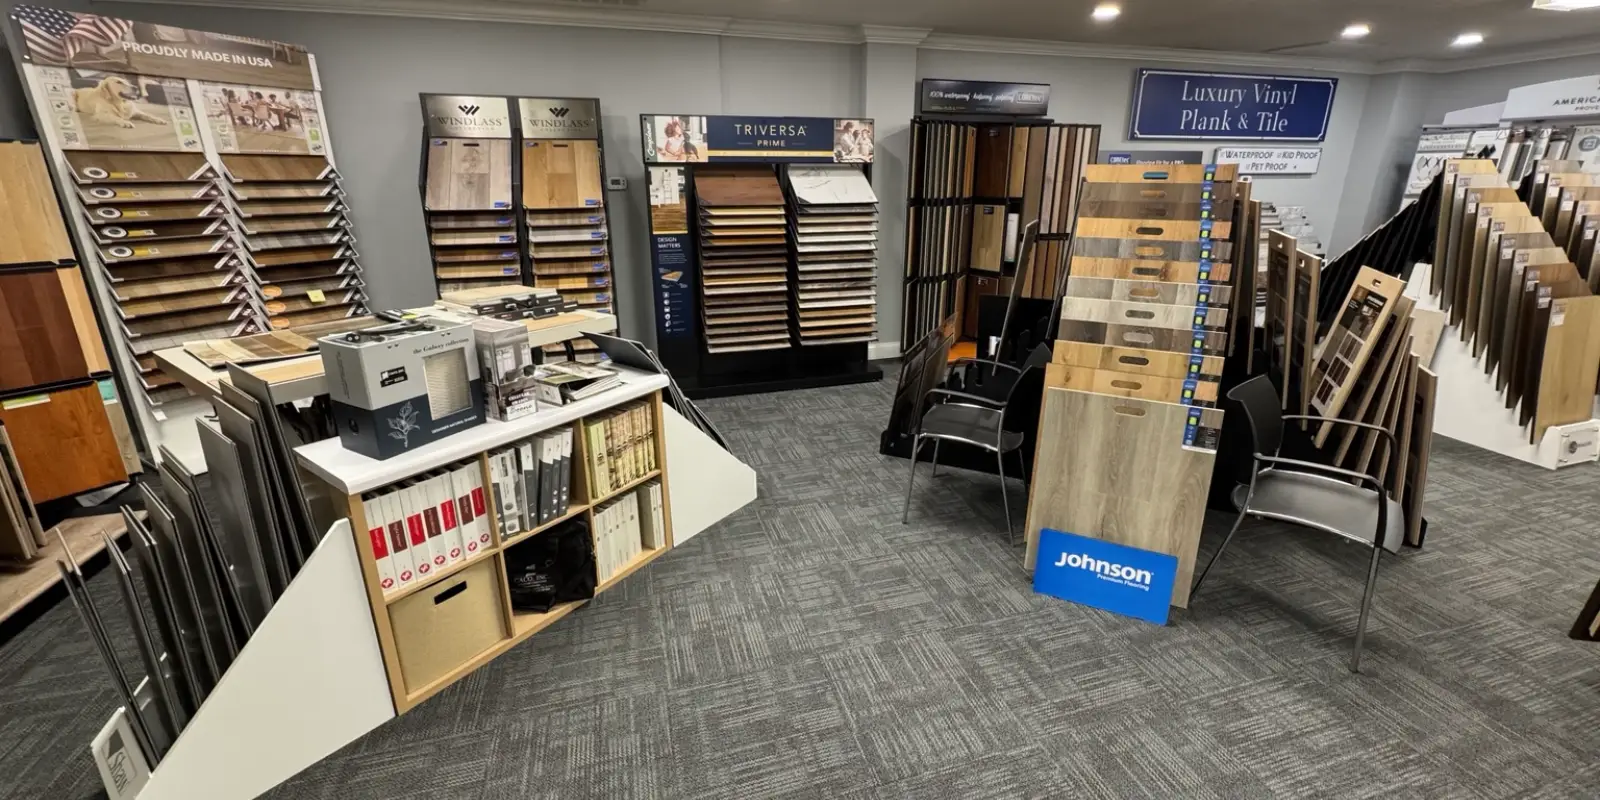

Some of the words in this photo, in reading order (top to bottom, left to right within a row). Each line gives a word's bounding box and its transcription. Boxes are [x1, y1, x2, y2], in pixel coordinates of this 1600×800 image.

[123, 41, 188, 60] PROUDLY
[191, 50, 231, 65] MADE
[231, 54, 246, 65] IN
[248, 56, 273, 68] USA
[1181, 80, 1247, 109] Luxury
[1254, 83, 1298, 110] Vinyl
[438, 116, 502, 127] WINDLASS
[529, 118, 590, 128] WINDLASS
[1180, 109, 1231, 131] Plank
[1238, 114, 1249, 130] &
[1257, 111, 1289, 132] Tile
[734, 124, 806, 136] TRIVERSA
[1226, 151, 1274, 159] WATERPROOF
[1295, 152, 1318, 160] PROOF
[1251, 163, 1265, 171] PET
[1265, 163, 1288, 171] PROOF
[1055, 552, 1151, 585] Johnson
[1097, 573, 1123, 585] Premium
[1124, 579, 1150, 592] Flooring
